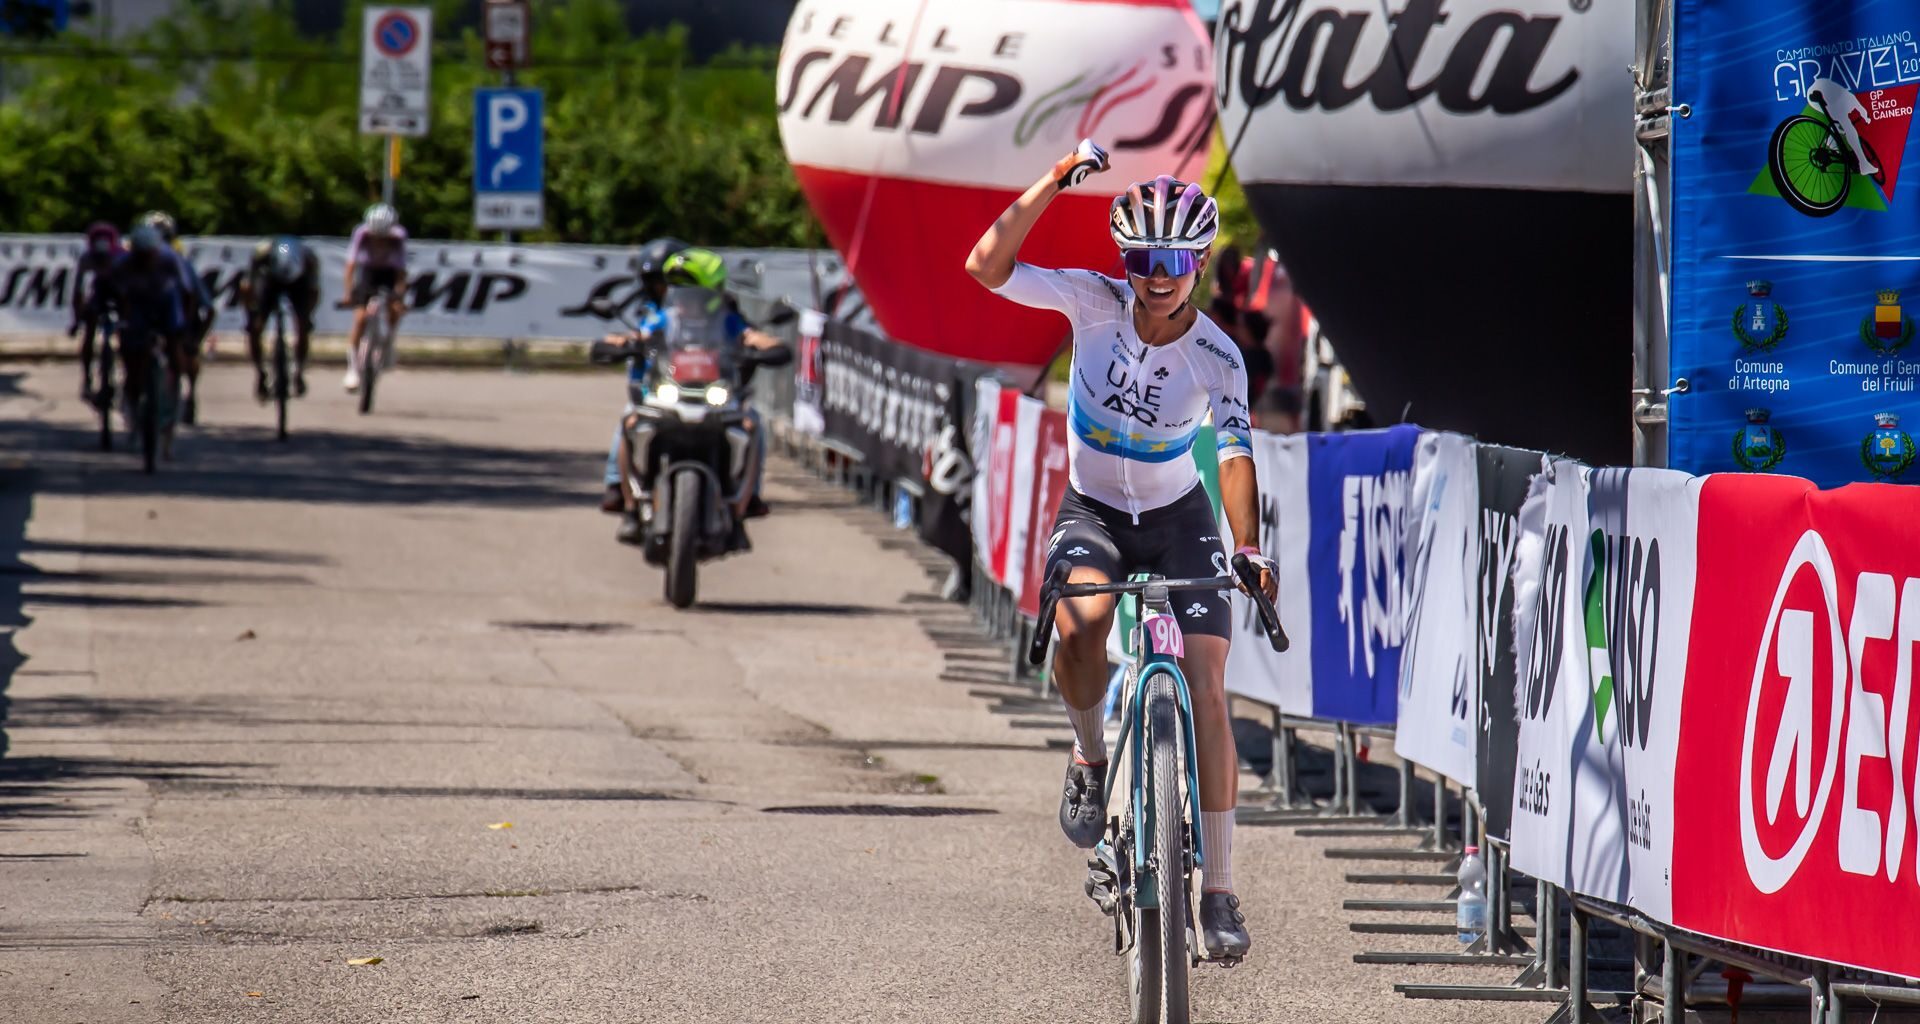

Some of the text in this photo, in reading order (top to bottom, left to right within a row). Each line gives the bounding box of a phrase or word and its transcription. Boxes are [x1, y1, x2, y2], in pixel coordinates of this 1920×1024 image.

[797, 10, 1026, 59] SELLE
[1776, 30, 1912, 62] CAMPIONATO ITALIANO
[1902, 58, 1920, 74] 20
[778, 50, 1023, 136] SMP
[1870, 89, 1884, 101] GP
[1871, 99, 1898, 111] ENZO
[1873, 106, 1914, 120] CAINERO
[488, 94, 528, 149] P
[1204, 342, 1240, 370] Analog
[1735, 358, 1784, 374] Comune
[1829, 359, 1879, 375] Comune
[1882, 360, 1894, 375] di
[1106, 360, 1162, 408] UAE
[1728, 376, 1790, 394] di Artegna
[1862, 377, 1914, 392] del Friuli
[1102, 393, 1158, 428] ADQ
[1155, 618, 1180, 655] 90
